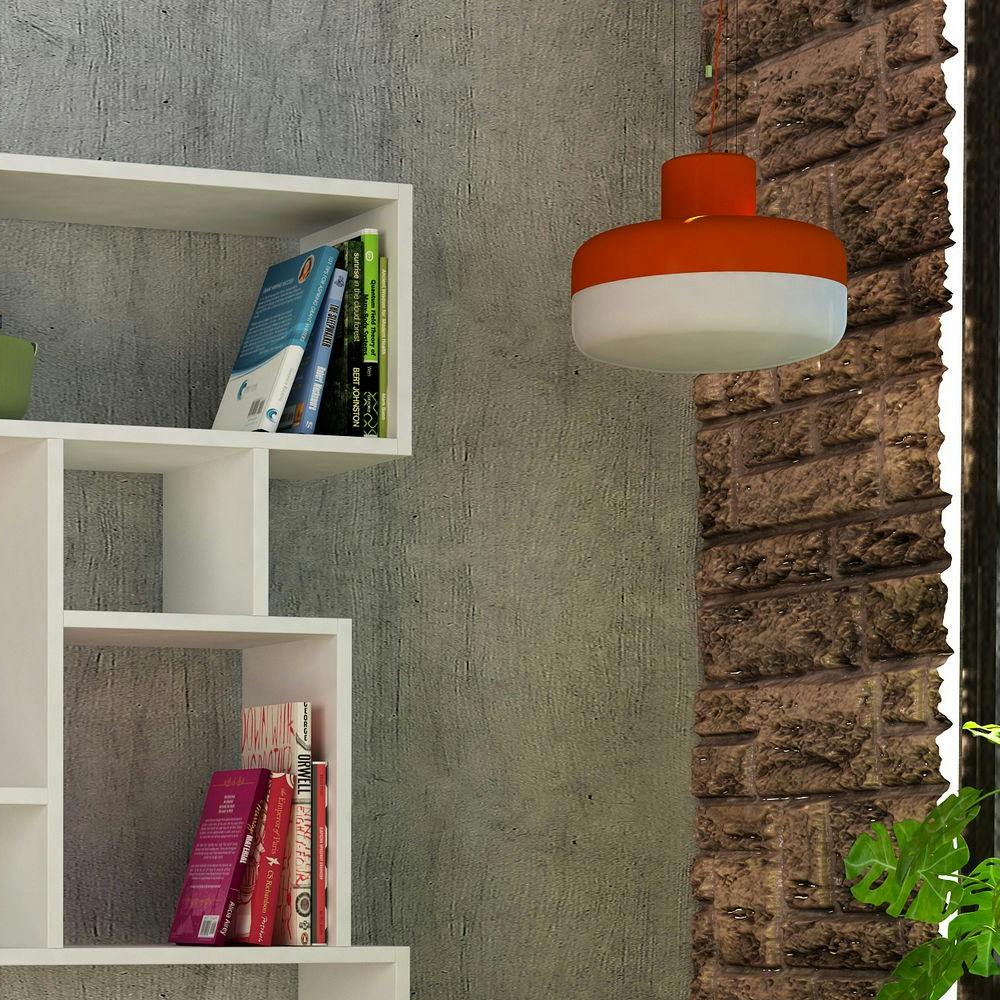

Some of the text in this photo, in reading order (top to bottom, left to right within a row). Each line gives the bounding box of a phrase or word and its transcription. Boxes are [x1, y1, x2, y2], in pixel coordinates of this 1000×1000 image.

[353, 288, 361, 300] the
[369, 279, 377, 309] Quantum
[353, 301, 361, 321] cloud
[353, 321, 361, 342] forest
[369, 326, 377, 347] Theory
[352, 367, 360, 428] BERT JOHNSTON
[297, 754, 311, 796] ORWELL
[274, 797, 286, 829] Emperor
[240, 834, 254, 864] MATERIAL
[271, 836, 281, 855] Paris
[261, 870, 274, 914] CS Richardson
[219, 919, 231, 936] Airey
